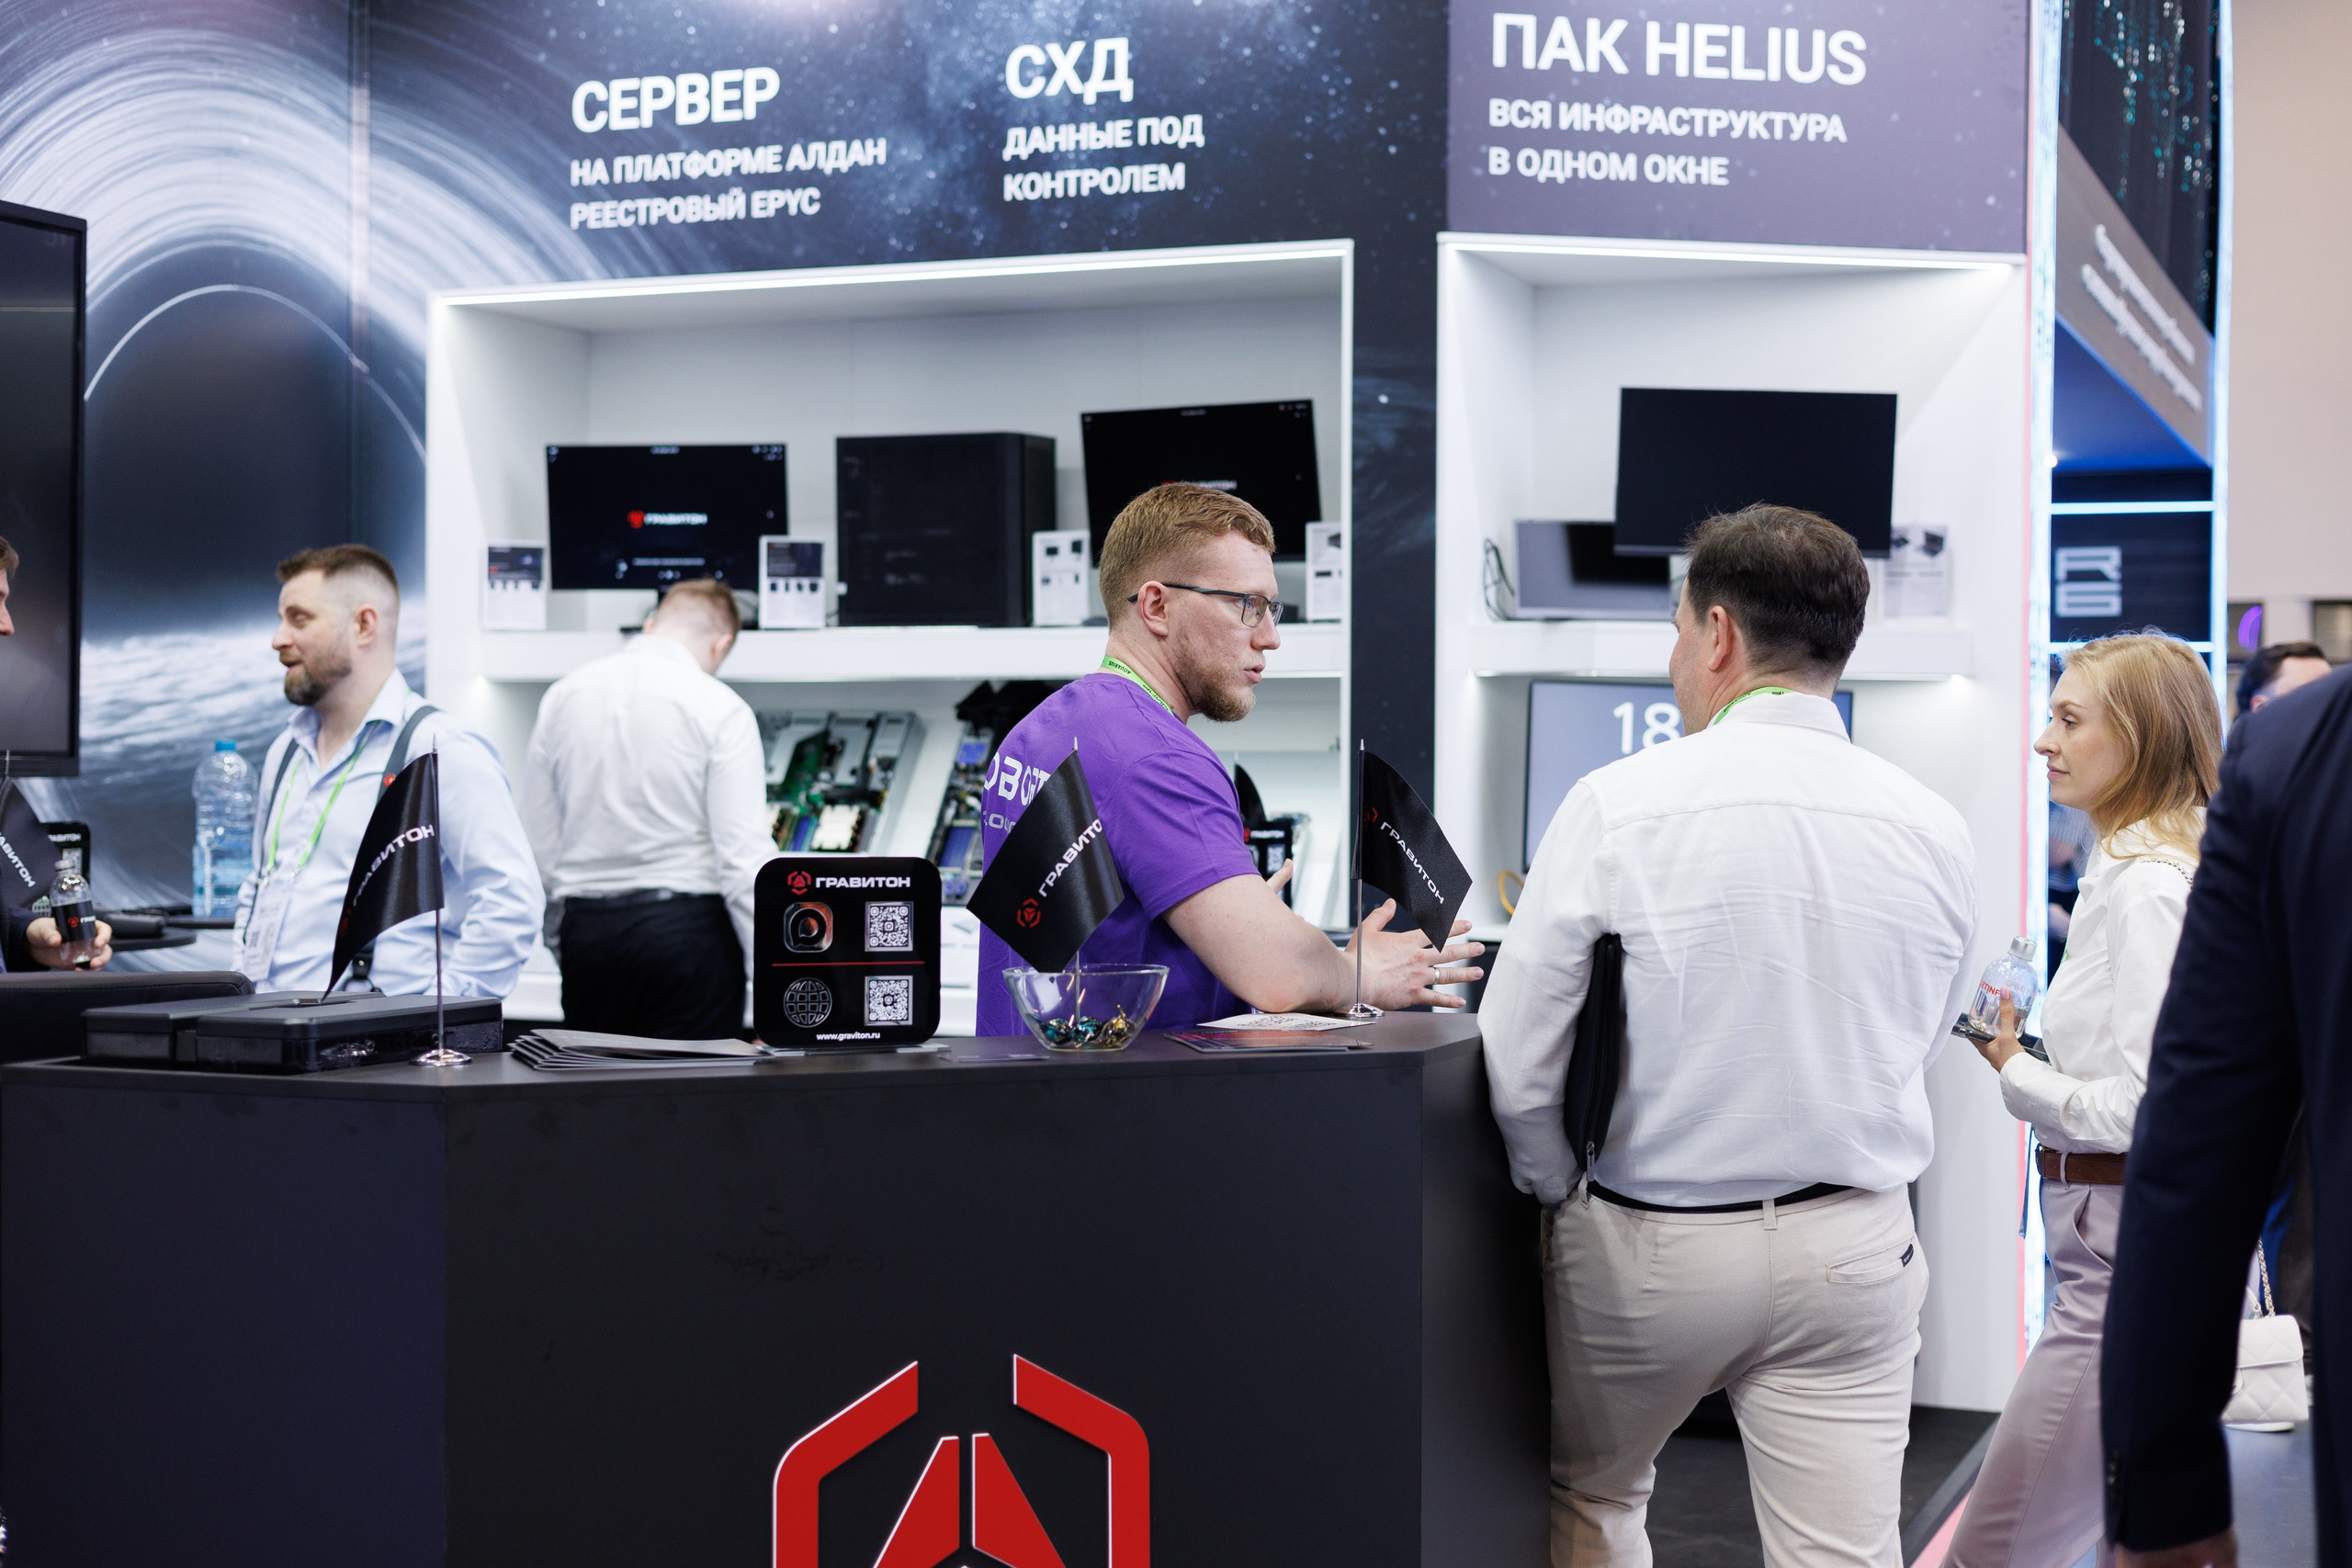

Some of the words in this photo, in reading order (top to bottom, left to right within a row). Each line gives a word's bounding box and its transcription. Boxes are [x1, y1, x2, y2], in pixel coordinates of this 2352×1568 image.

[1004, 37, 1134, 106] СХД
[1491, 12, 1629, 74] ПАК
[1645, 20, 1868, 85] HELIUS
[571, 66, 781, 134] СЕРВЕР
[1488, 97, 1552, 130] ВСЯ
[1558, 101, 1849, 144] ИНФРАСТРУКТУРА
[571, 158, 610, 186] НА
[613, 144, 783, 185] ПЛАТФОРМЕ
[786, 137, 888, 175] АЛДАН
[1002, 118, 1133, 162] ДАННЫЕ
[1137, 113, 1205, 149] ПОД
[1003, 163, 1185, 202] КОНТРОЛЕМ
[1488, 146, 1511, 176] В
[1517, 147, 1638, 185] ОДНОМ
[1644, 153, 1730, 186] ОКНЕ
[570, 187, 746, 230] РЕЕСТРОВЫЙ
[0, 831, 36, 888] АВИТОН
[815, 876, 911, 888] ГРАВИТОН
[1038, 818, 1102, 897] ГРАВИТО
[1380, 821, 1444, 905] ГРАВИТОН
[816, 1031, 881, 1041] www.graviton.ru
